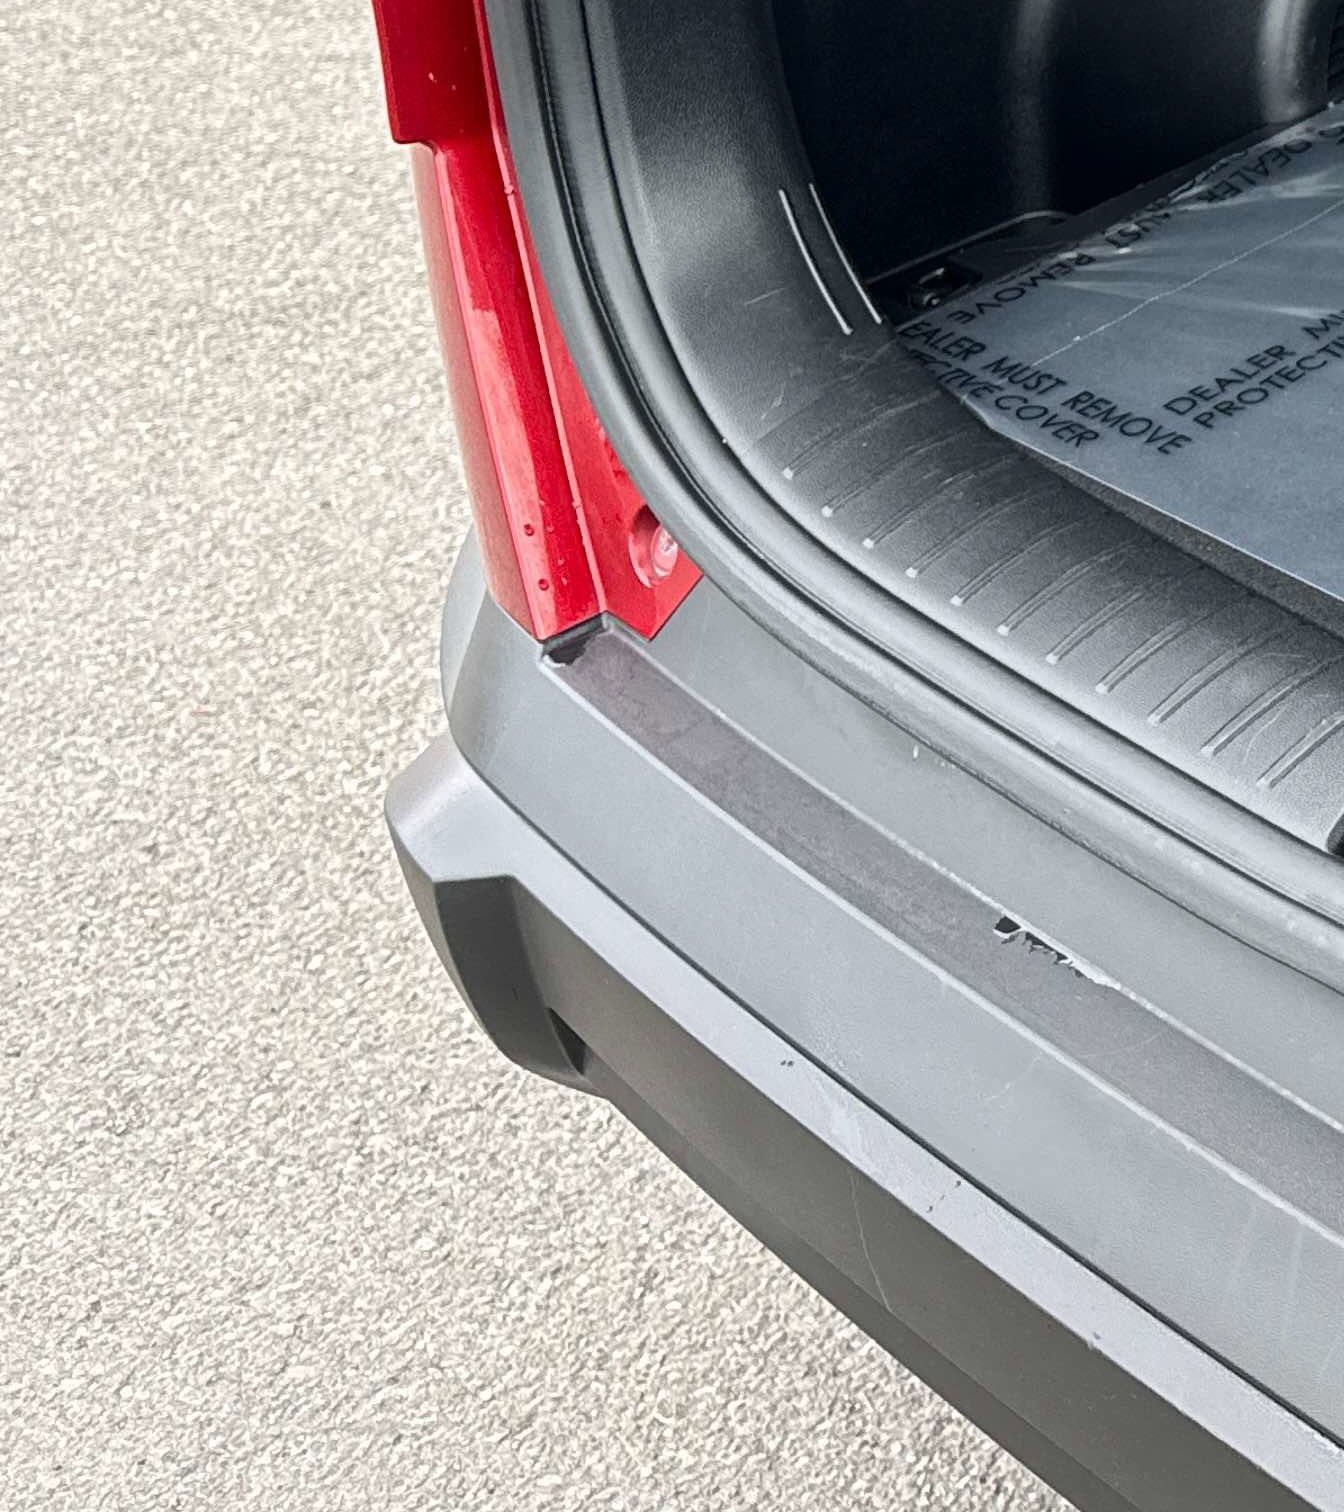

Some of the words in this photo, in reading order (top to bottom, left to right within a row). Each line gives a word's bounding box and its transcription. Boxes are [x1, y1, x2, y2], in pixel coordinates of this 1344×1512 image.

[897, 320, 986, 362] EALER
[982, 356, 1067, 395] MUST
[1061, 390, 1193, 455] REMOVE
[1163, 344, 1297, 416] DEALER
[994, 394, 1100, 448] COVER
